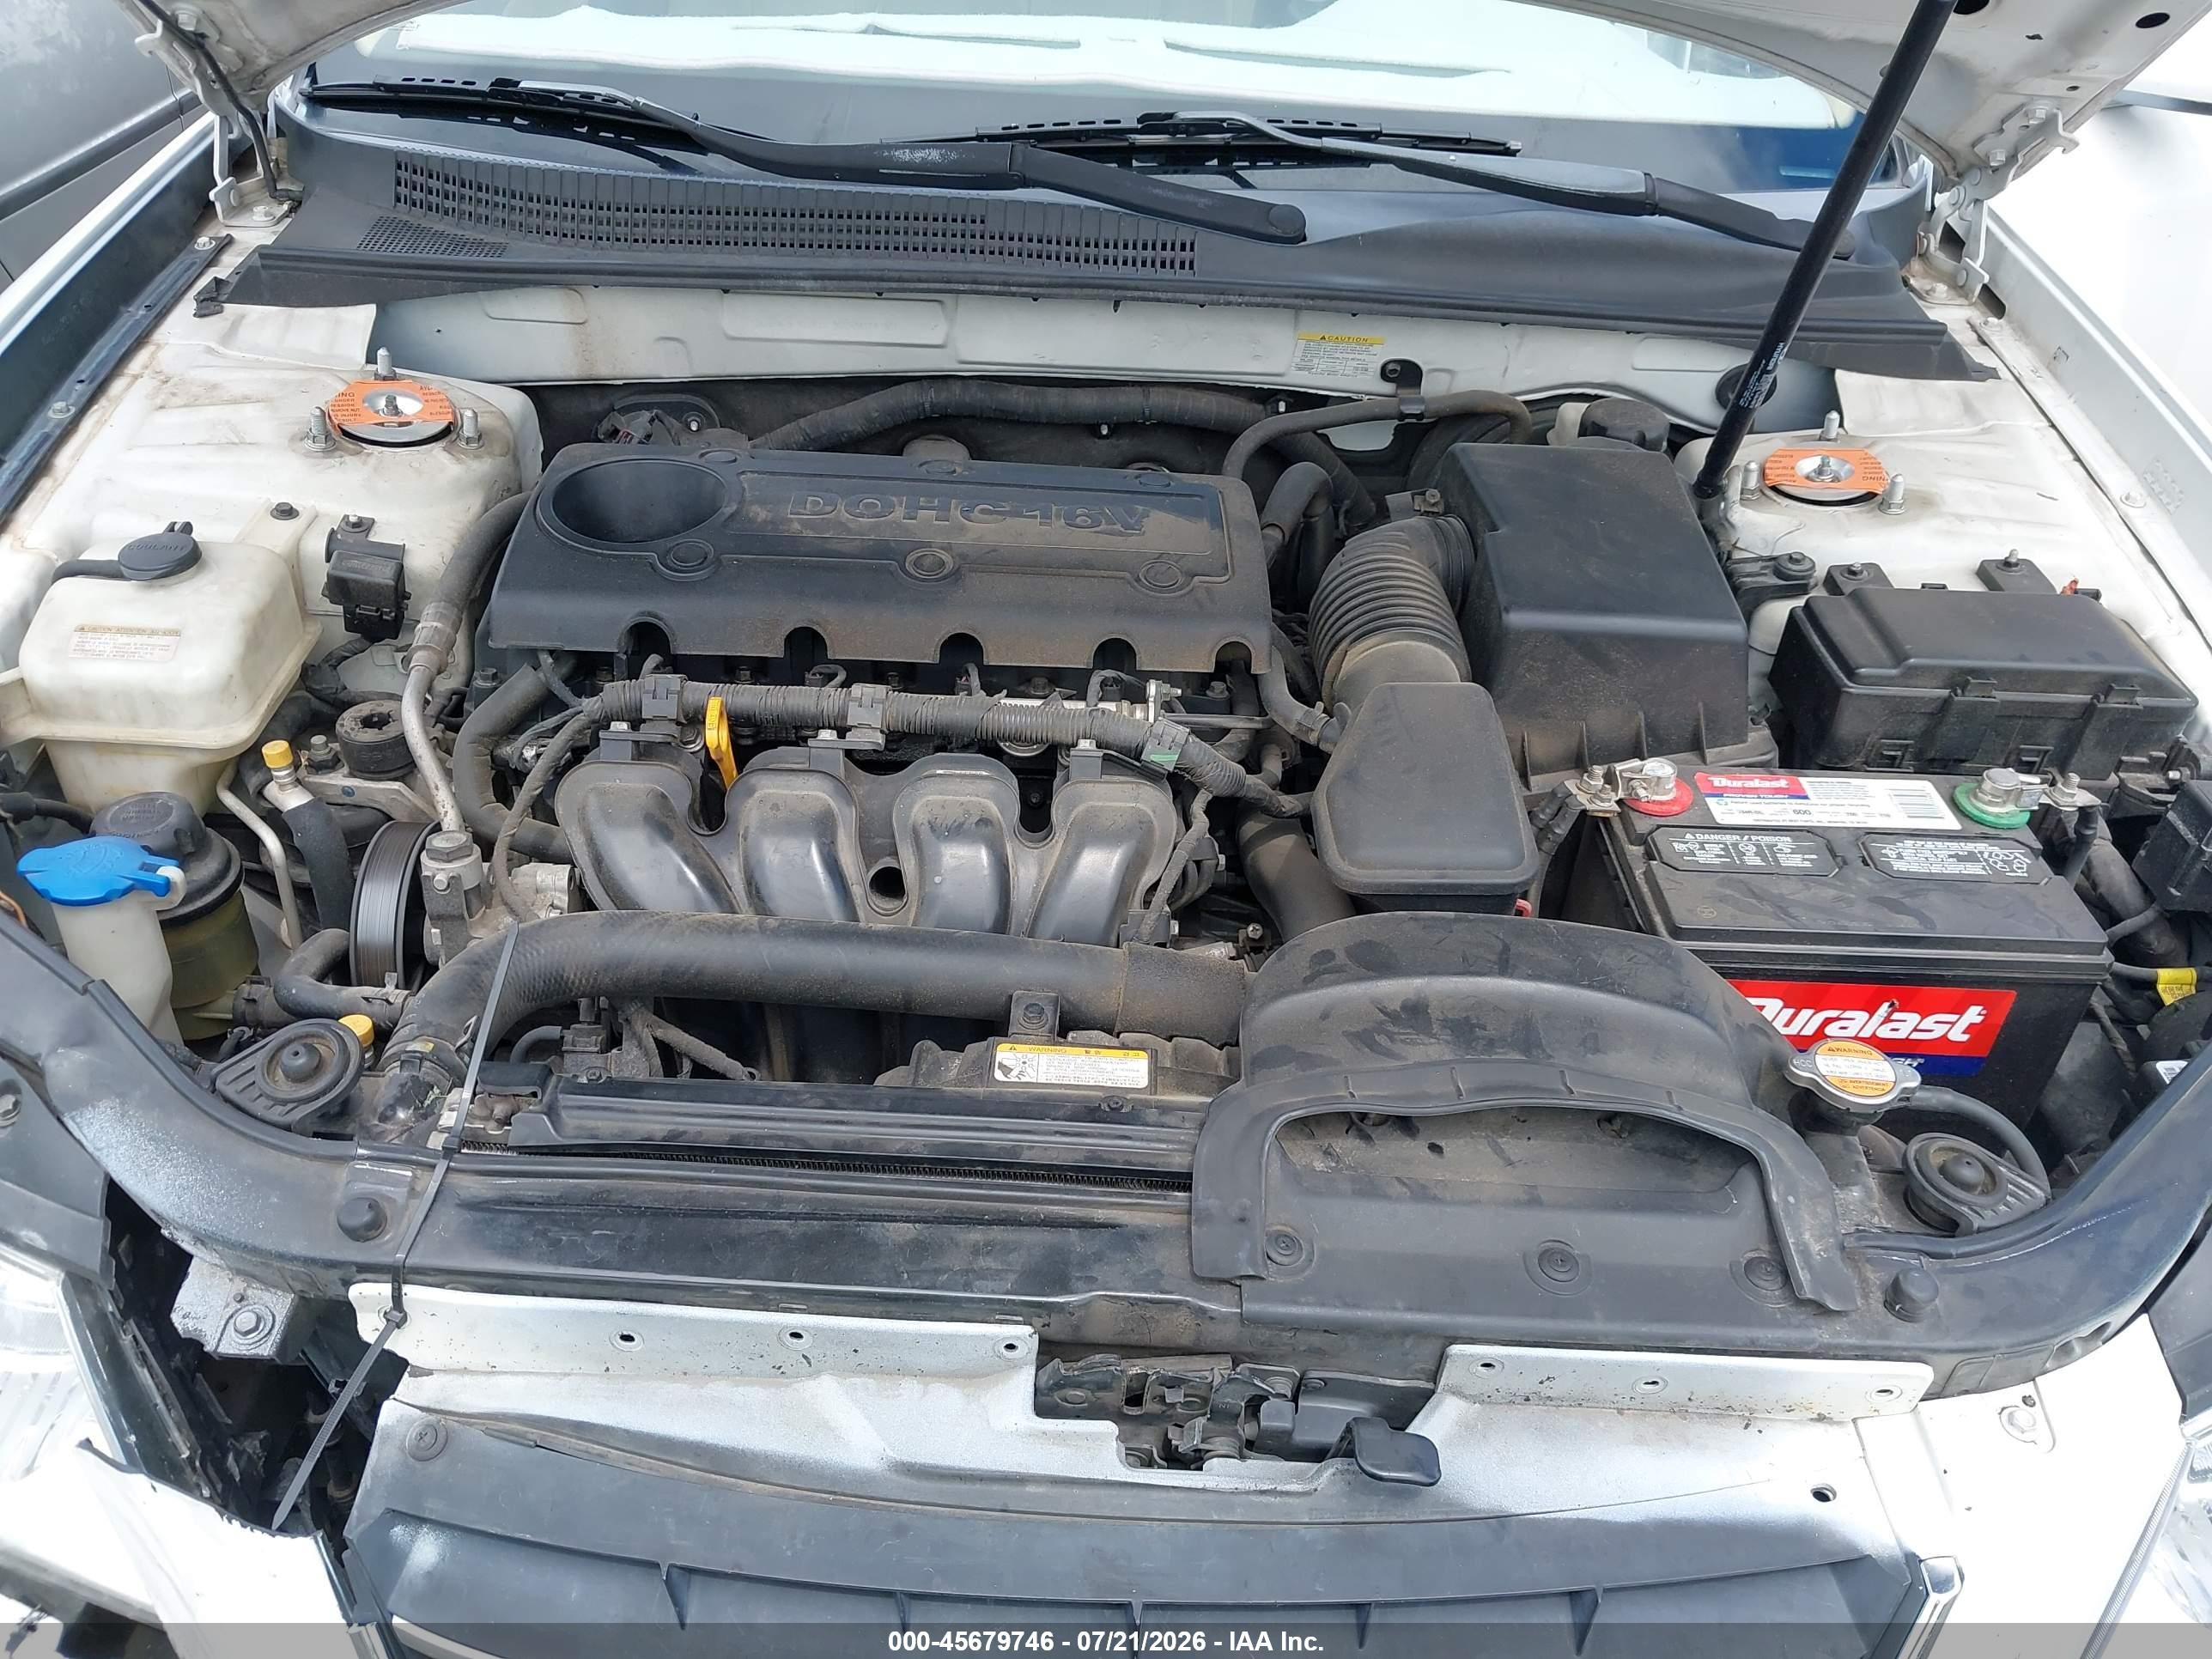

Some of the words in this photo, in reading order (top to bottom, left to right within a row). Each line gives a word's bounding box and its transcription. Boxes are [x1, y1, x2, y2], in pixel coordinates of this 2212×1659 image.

[787, 492, 1012, 526] DOHC
[1708, 777, 1790, 787] Duralast
[1835, 1047, 1873, 1055] WARNING
